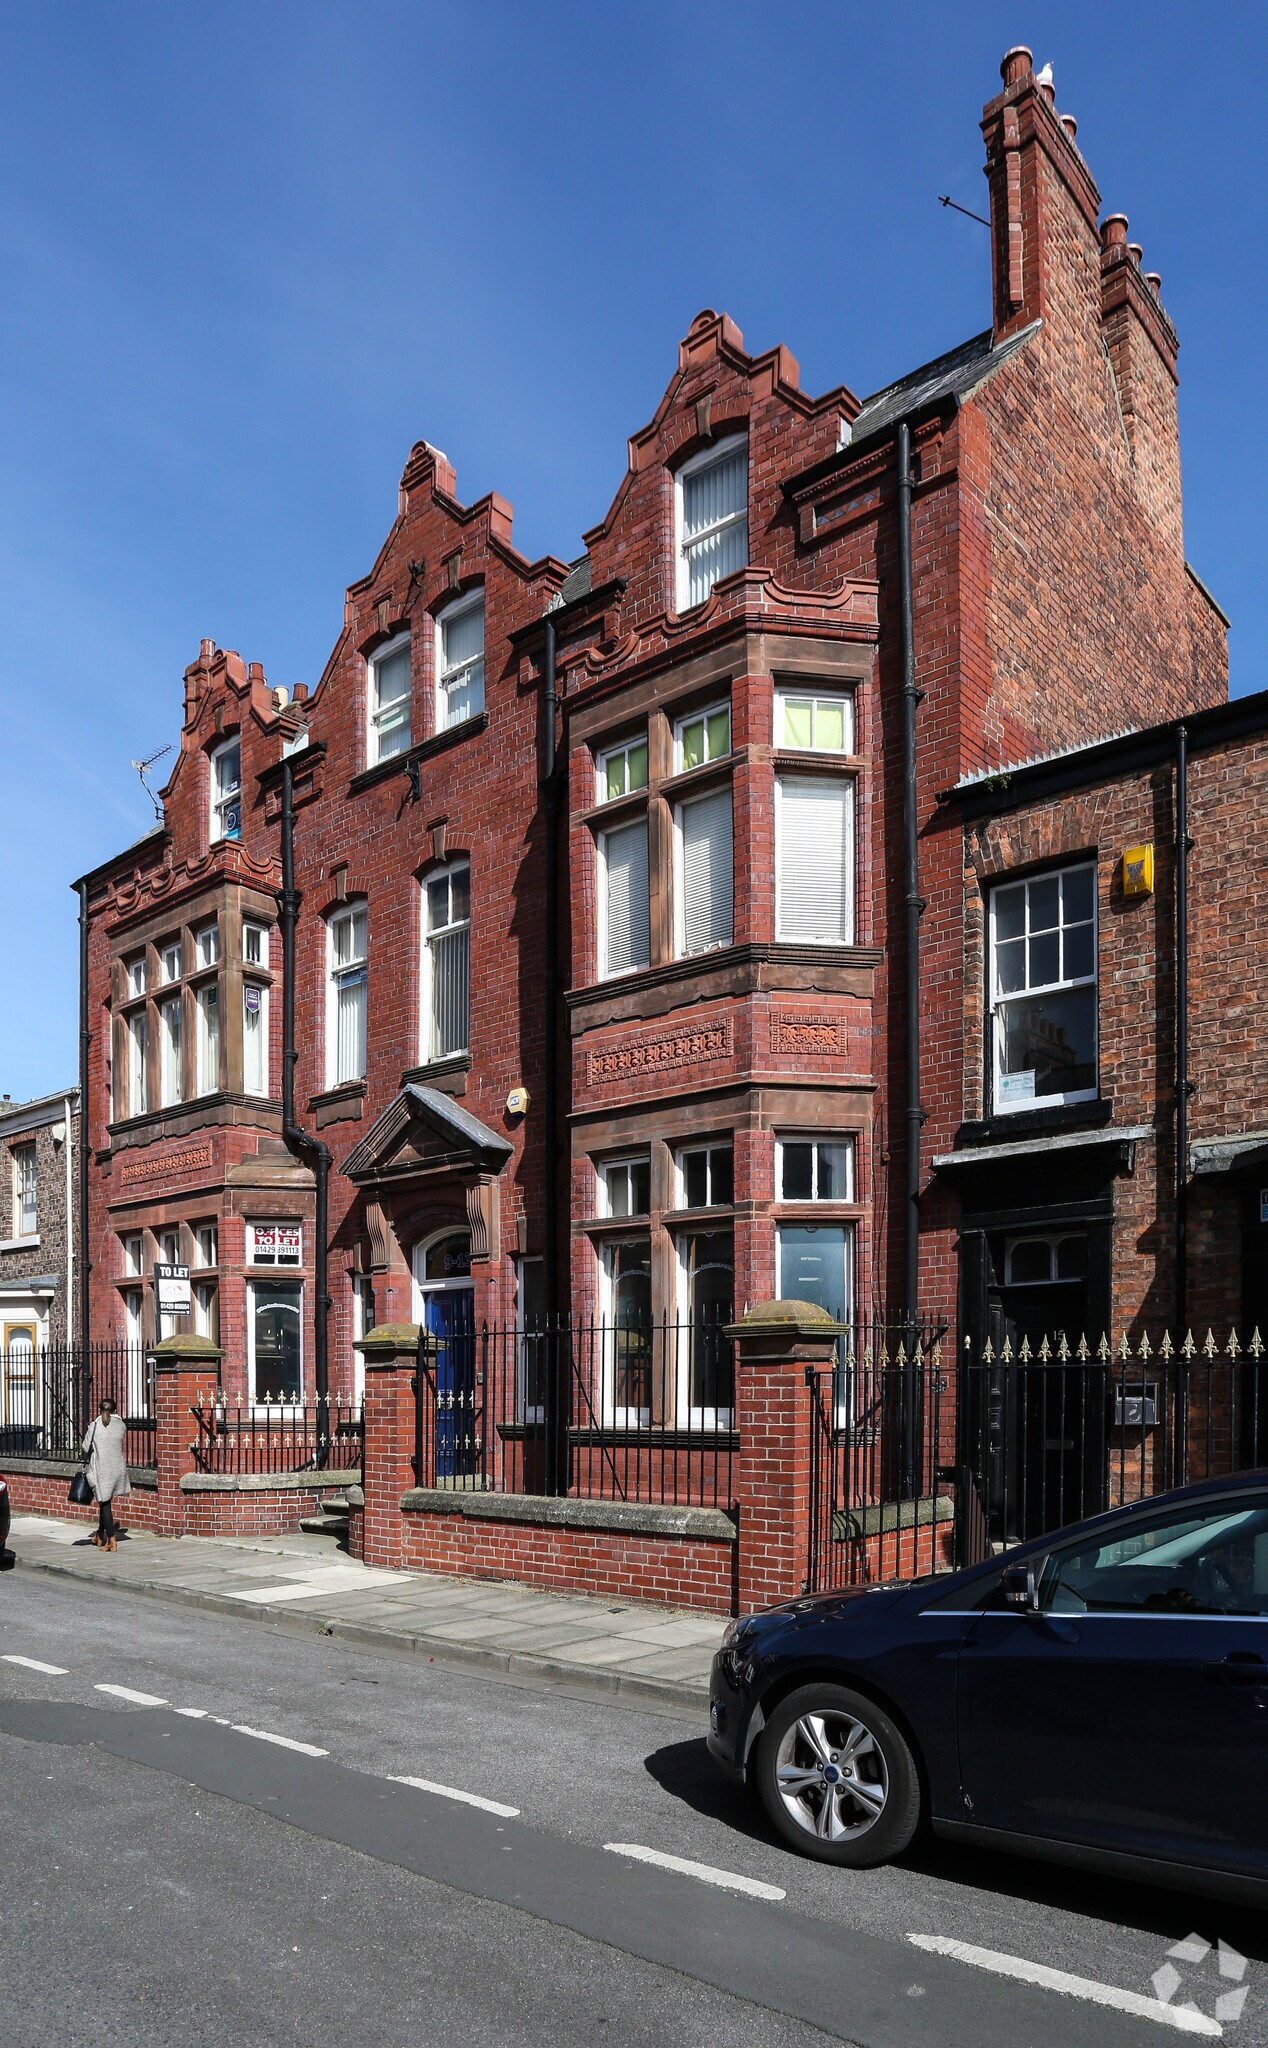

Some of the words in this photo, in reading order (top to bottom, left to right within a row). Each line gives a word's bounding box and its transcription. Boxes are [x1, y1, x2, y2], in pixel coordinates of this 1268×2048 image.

[255, 1227, 299, 1236] OFCES
[257, 1236, 273, 1245] TO
[278, 1236, 298, 1245] LET
[255, 1246, 275, 1254] 01429
[160, 1266, 172, 1277] TO
[173, 1267, 189, 1278] LET
